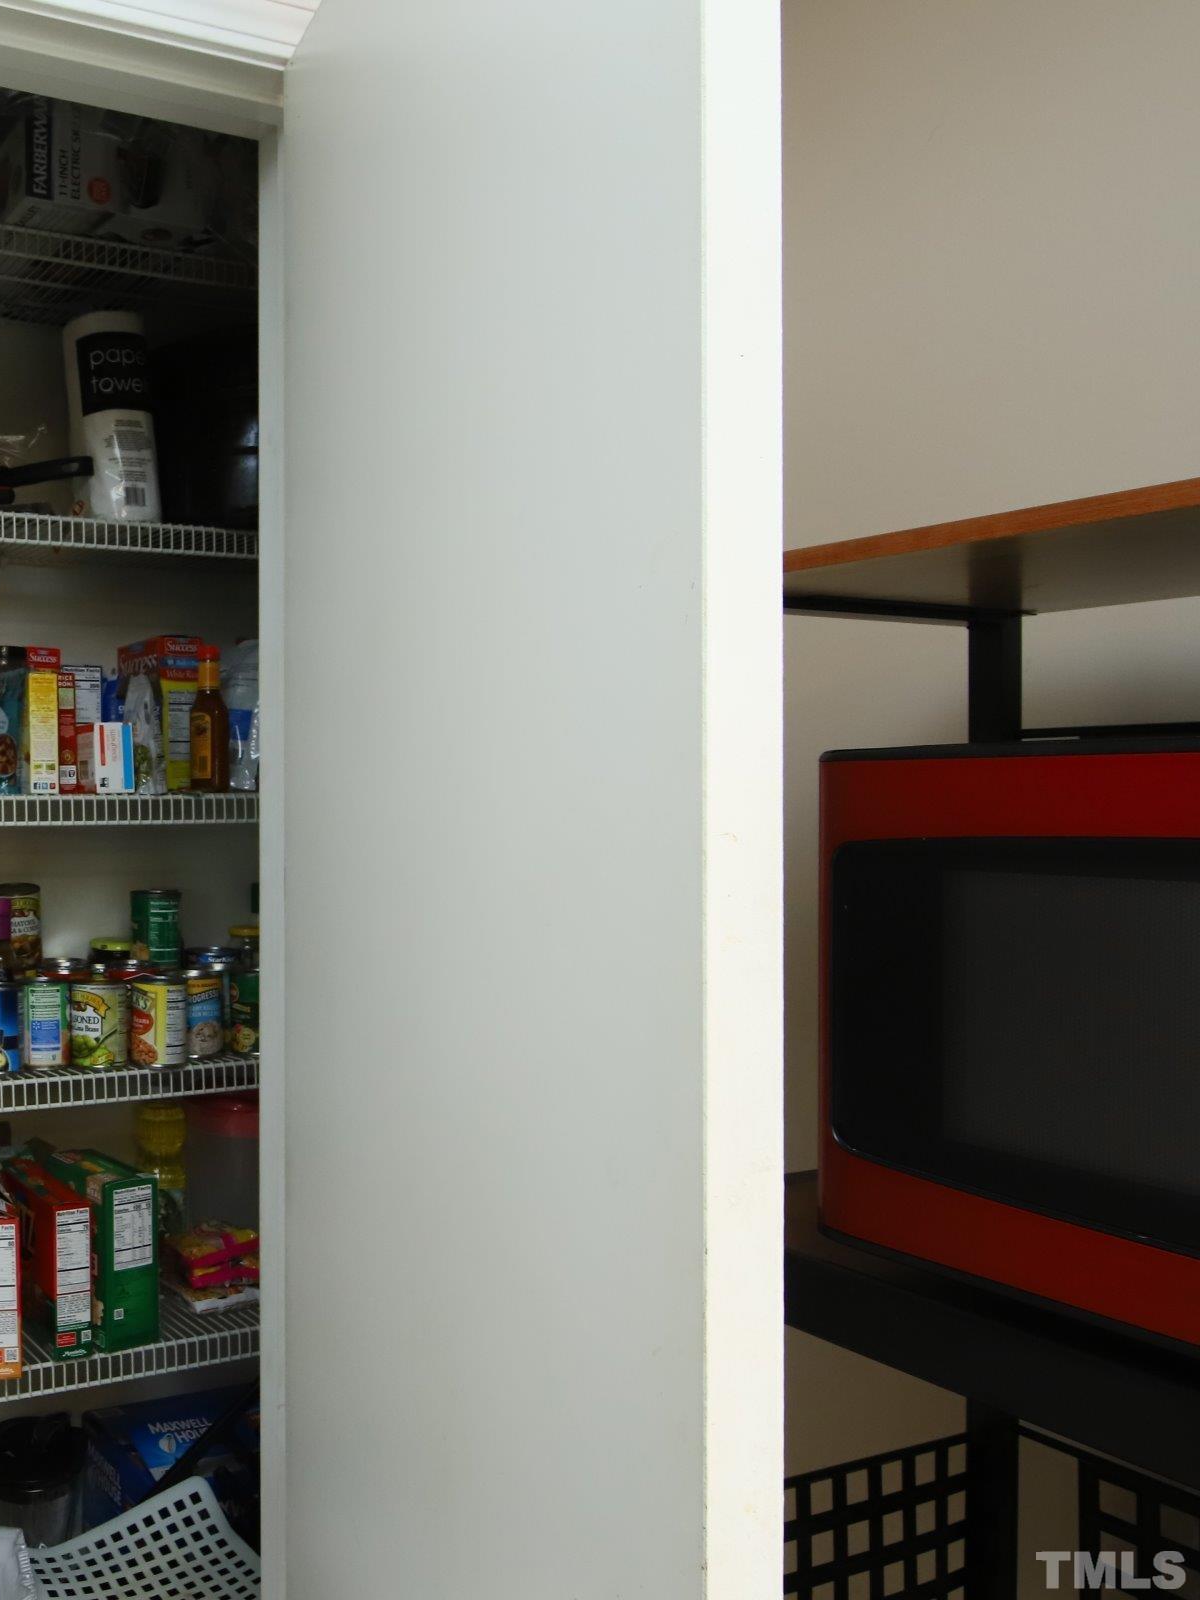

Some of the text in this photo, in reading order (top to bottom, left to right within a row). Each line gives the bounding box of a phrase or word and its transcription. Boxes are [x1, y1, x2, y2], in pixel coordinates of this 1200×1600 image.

[166, 640, 198, 653] Success
[29, 653, 58, 664] Success
[147, 1417, 213, 1435] MAXWELL
